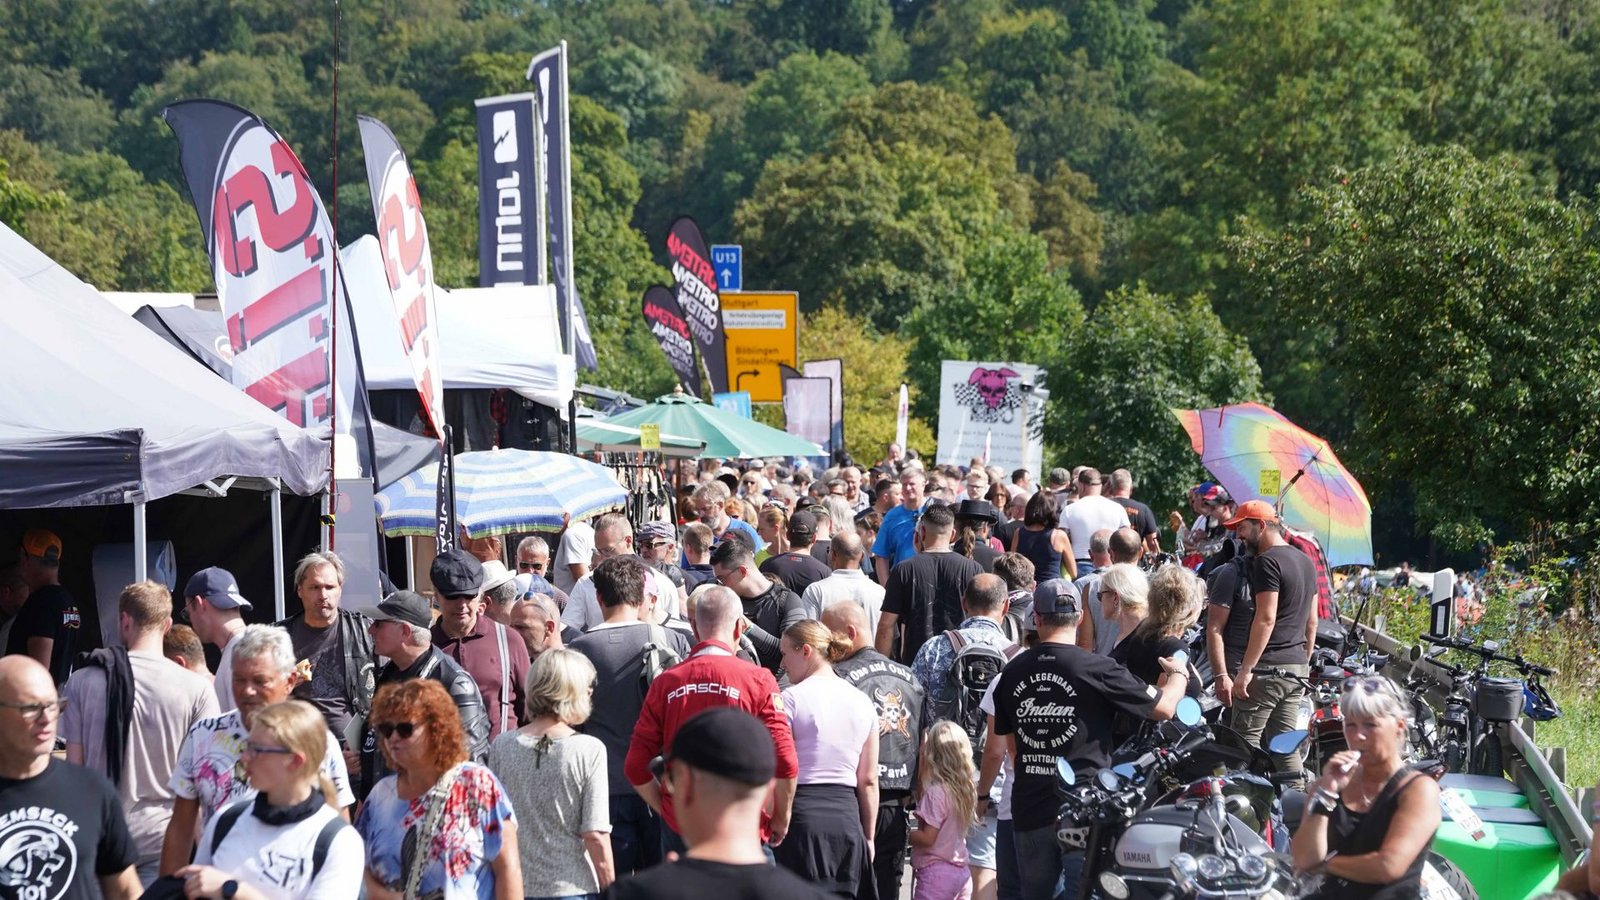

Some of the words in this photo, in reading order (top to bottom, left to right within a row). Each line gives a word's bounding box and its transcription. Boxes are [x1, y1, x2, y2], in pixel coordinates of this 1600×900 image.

[716, 252, 737, 264] U13
[850, 667, 869, 681] One
[868, 661, 888, 673] and
[888, 663, 912, 682] Only
[667, 683, 740, 704] PORSCHE
[1013, 681, 1027, 698] THE
[1030, 672, 1078, 697] LEGENDARY
[1016, 697, 1075, 718] Indian
[1017, 727, 1046, 750] GENUNE
[1050, 724, 1078, 748] BRAND
[1022, 754, 1059, 764] STUTTGAR
[1025, 765, 1057, 776] GERMAN
[1123, 851, 1152, 863] YAMAHA
[16, 884, 48, 900] 101
